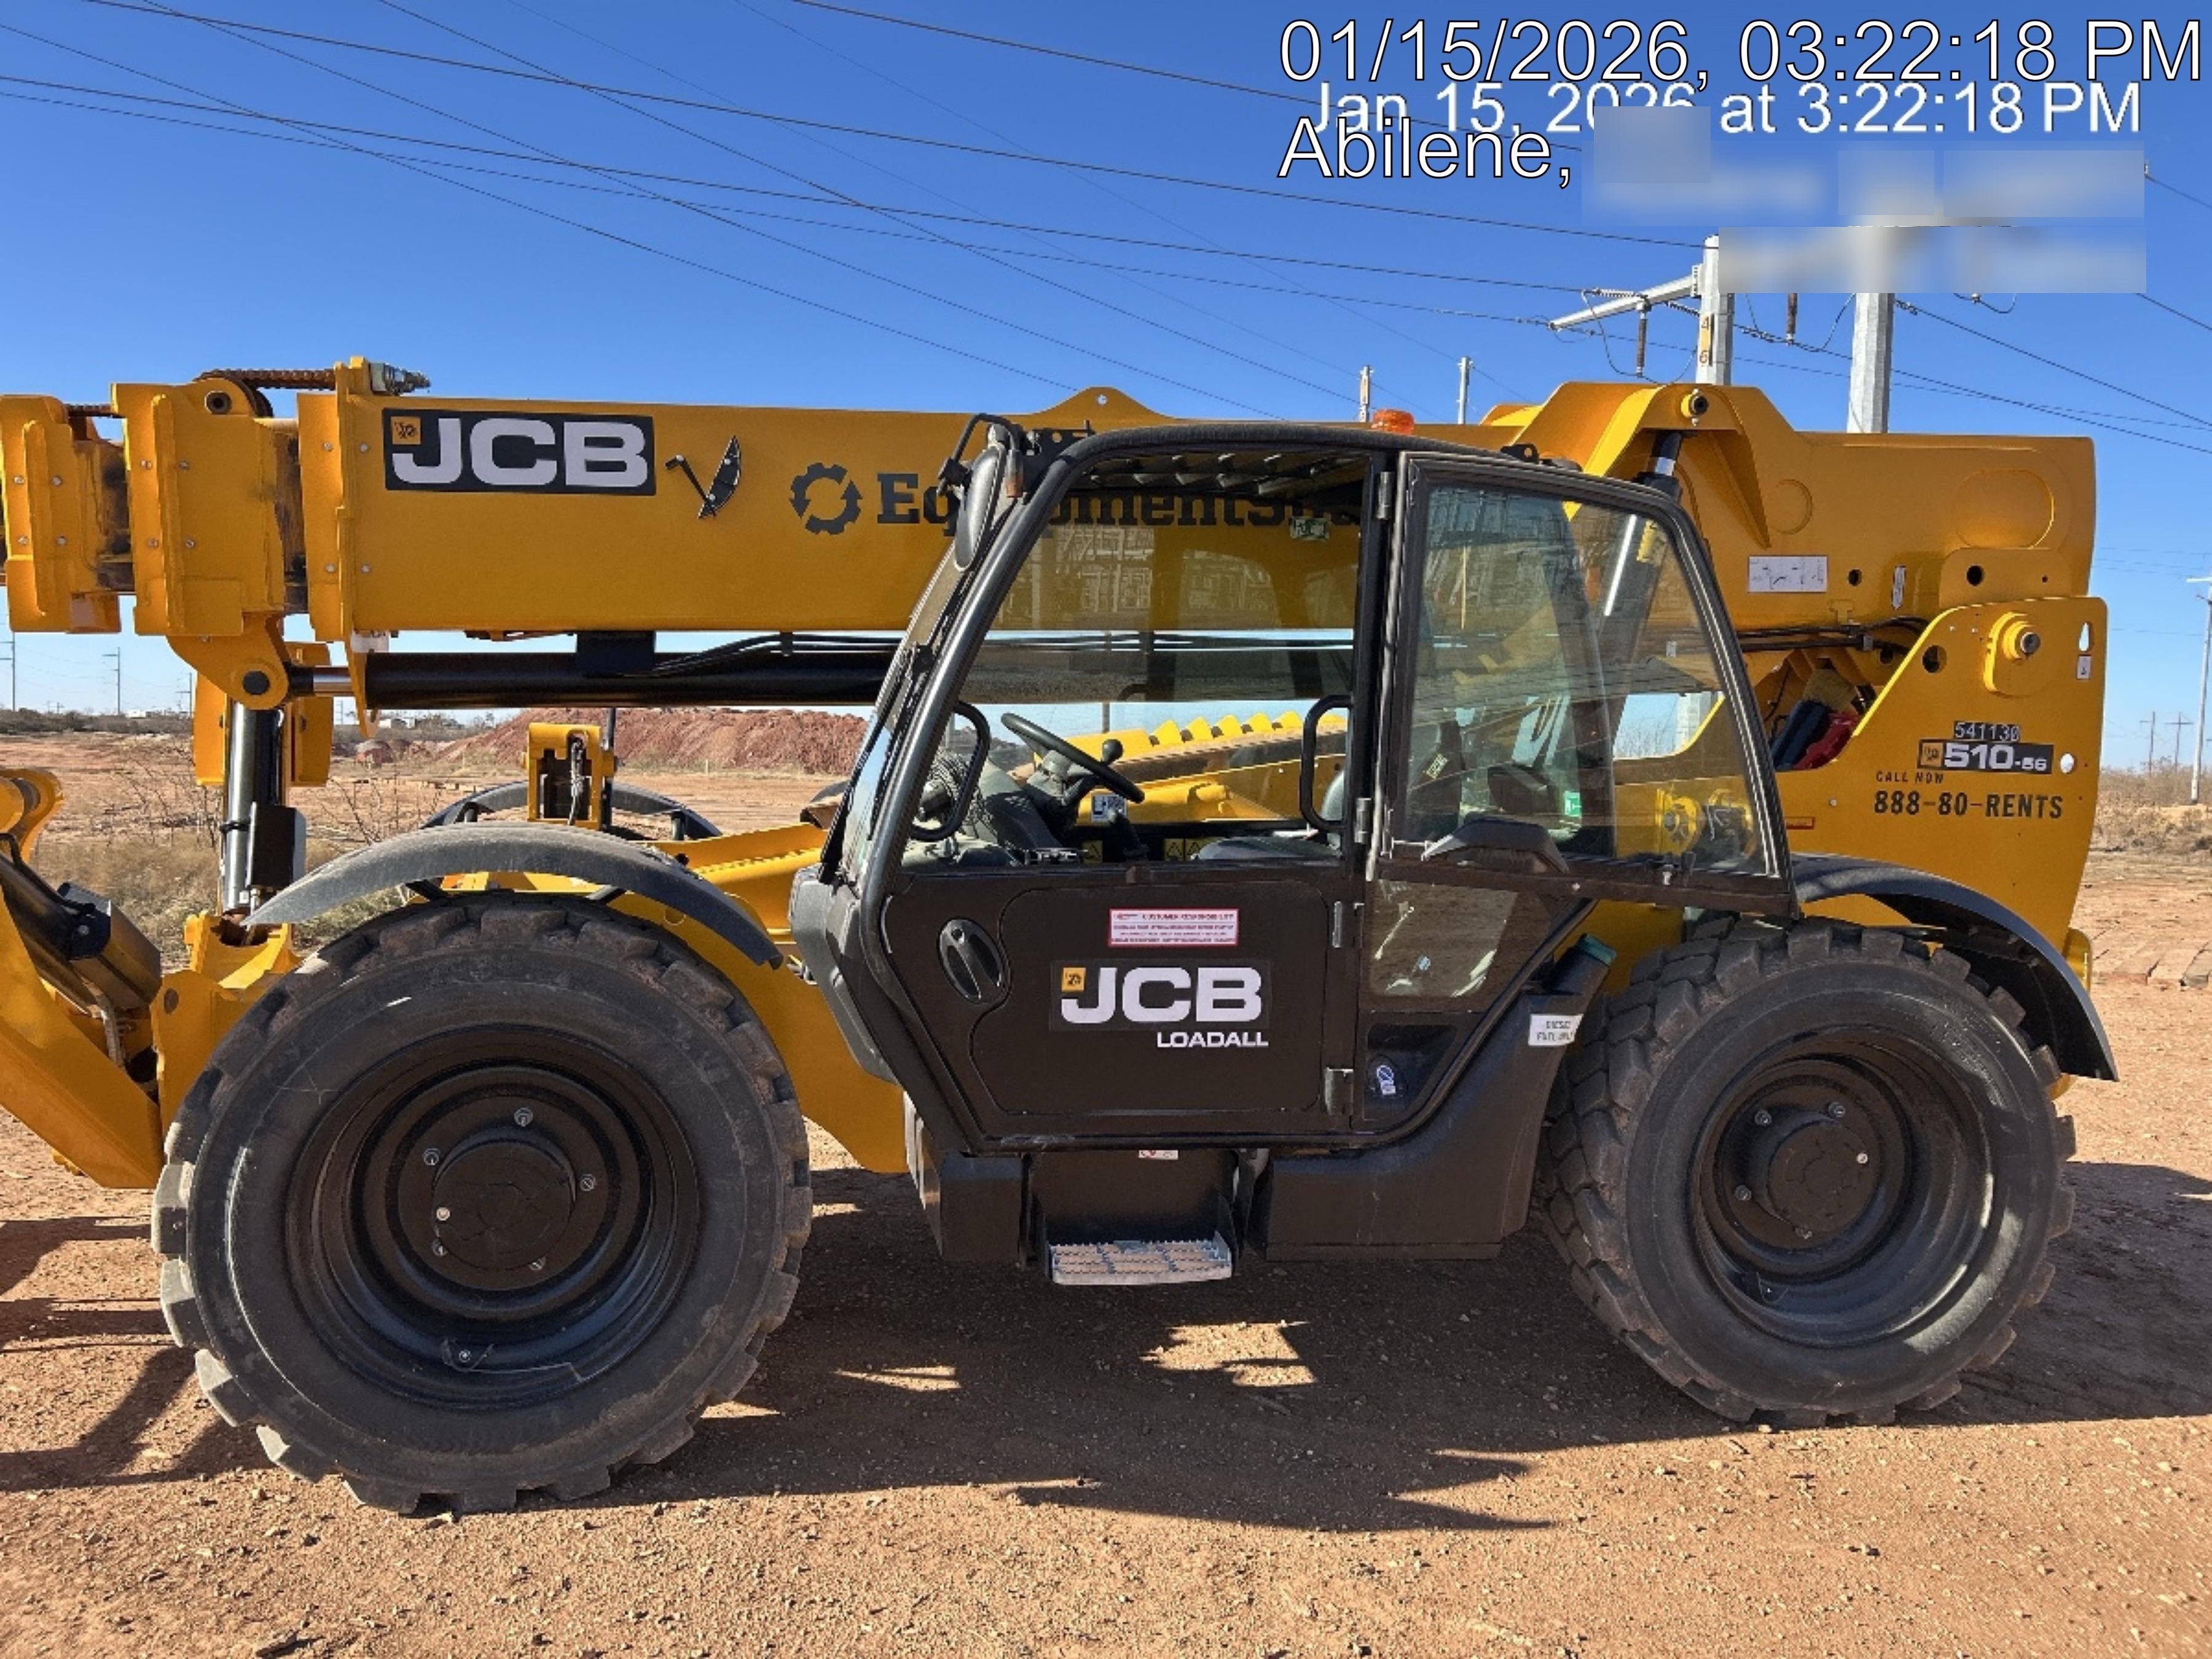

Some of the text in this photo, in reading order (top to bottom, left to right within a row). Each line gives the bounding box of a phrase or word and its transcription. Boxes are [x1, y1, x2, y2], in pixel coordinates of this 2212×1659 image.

[391, 418, 648, 487] JCB
[1875, 771, 1944, 784] CALL NOW
[1874, 790, 2063, 819] 888-80-RENTS
[1061, 967, 1262, 1024] JCB
[1157, 1032, 1269, 1048] LOADALL
